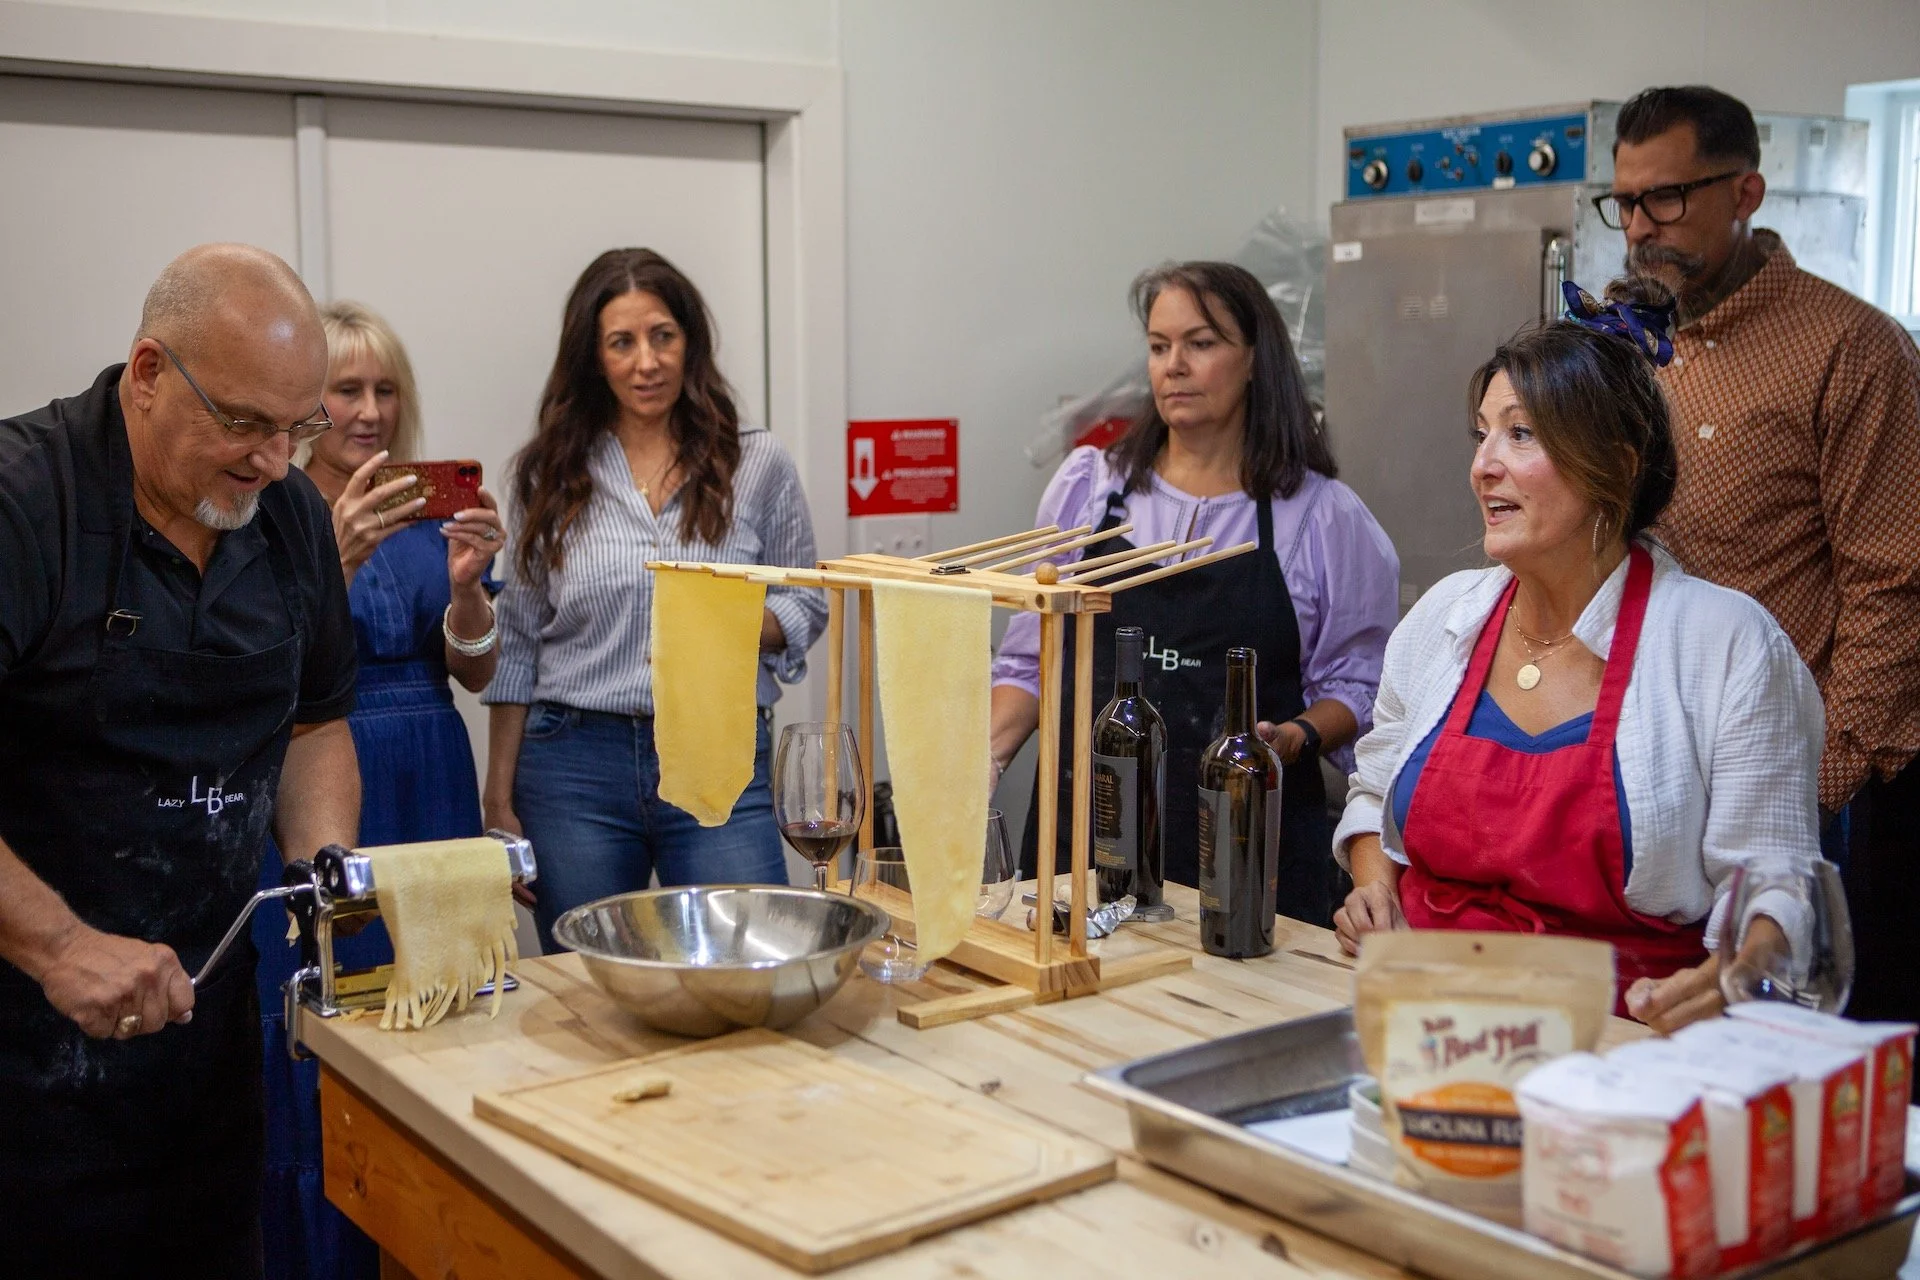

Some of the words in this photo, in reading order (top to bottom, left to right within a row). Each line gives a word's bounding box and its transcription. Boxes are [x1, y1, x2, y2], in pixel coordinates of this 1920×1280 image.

[1180, 658, 1202, 668] BEAR
[157, 797, 186, 808] LAZY
[224, 792, 244, 803] BEAR
